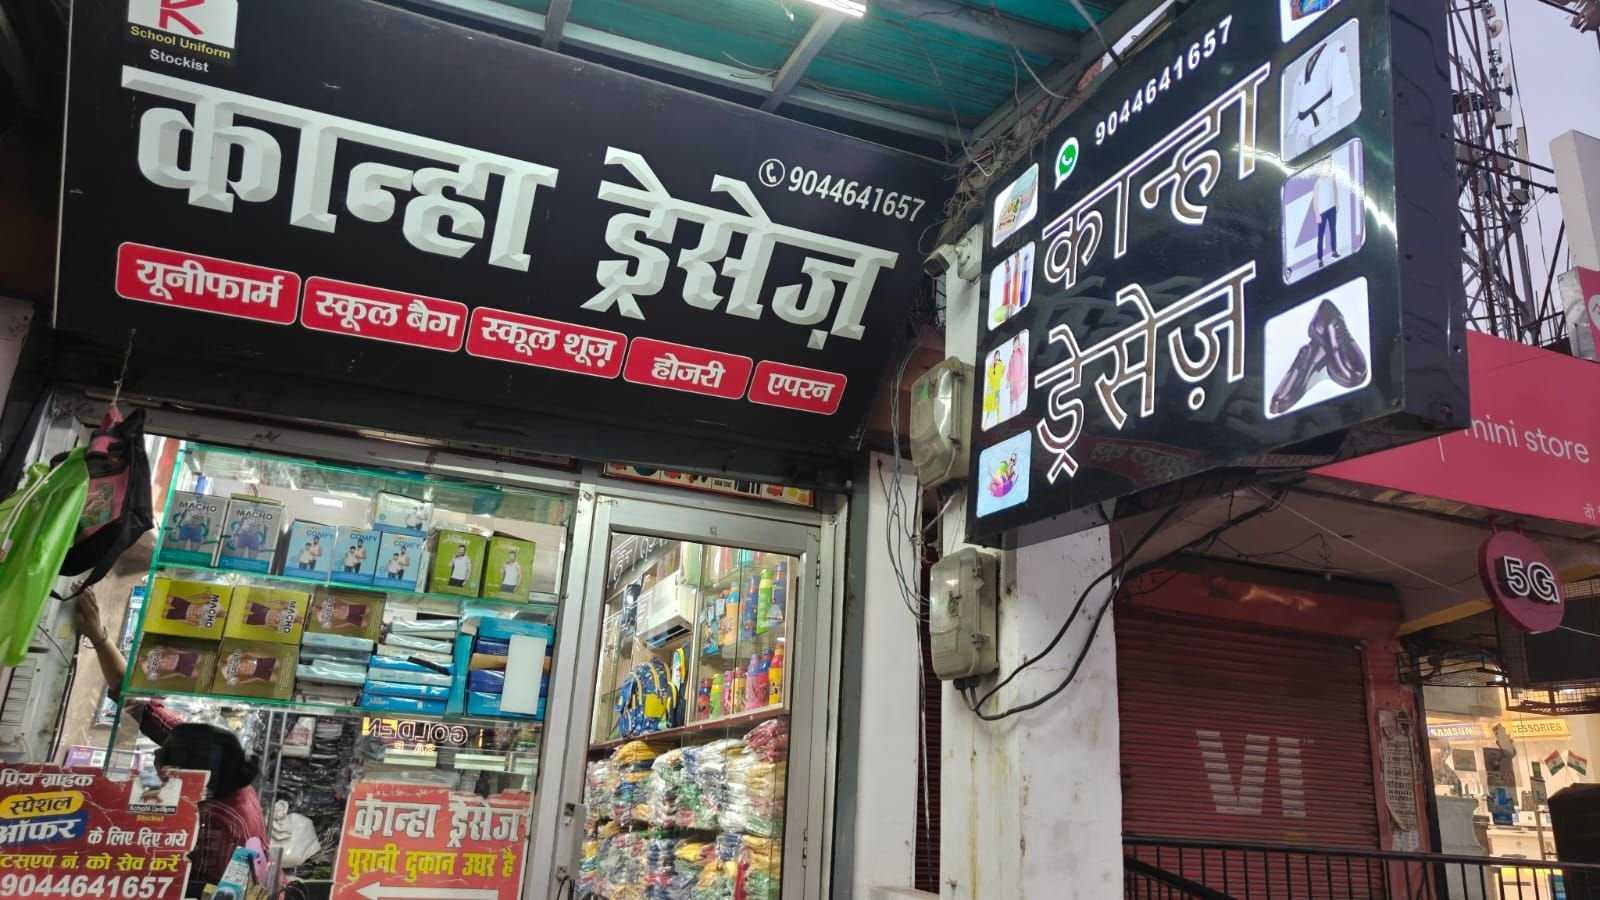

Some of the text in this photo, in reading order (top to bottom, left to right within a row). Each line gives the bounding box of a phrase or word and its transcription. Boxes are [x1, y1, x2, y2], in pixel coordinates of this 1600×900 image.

[130, 25, 231, 60] School Uniform
[149, 48, 209, 73] Stockist
[1095, 14, 1232, 146] 9044641657
[1042, 61, 1270, 289] कान्हा
[122, 64, 900, 351] कान्हा ड्रेसेज़
[788, 165, 926, 223] 9044641657
[135, 258, 285, 308] यूनीफार्म
[315, 290, 461, 337] स्कूल बैग
[481, 316, 617, 368] स्कूल शूज़
[651, 351, 726, 389] होजरी
[767, 372, 835, 402] एपरन
[1034, 260, 1256, 485] ड्रेसेज़
[1524, 428, 1590, 464] store
[179, 501, 217, 513] MACHO
[236, 509, 273, 521] MACHO
[350, 533, 378, 542] COMFY
[1502, 555, 1560, 604] 5G
[205, 594, 220, 629] MACHO
[283, 600, 297, 634] MACHO
[1431, 726, 1475, 737] SAMSUN
[0, 768, 96, 788] प्रिय ग्राहक
[9, 796, 74, 815] स्पेशल
[355, 796, 441, 839] कान्हा
[0, 819, 82, 845] ऑफर
[87, 826, 189, 847] के लिए दिए गये
[86, 852, 114, 871] को
[117, 853, 145, 872] सेव
[150, 853, 182, 872] करें
[346, 843, 400, 881] पुरानी
[405, 851, 457, 883] दुकान
[502, 848, 517, 878] है
[0, 873, 174, 899] 9044641657
